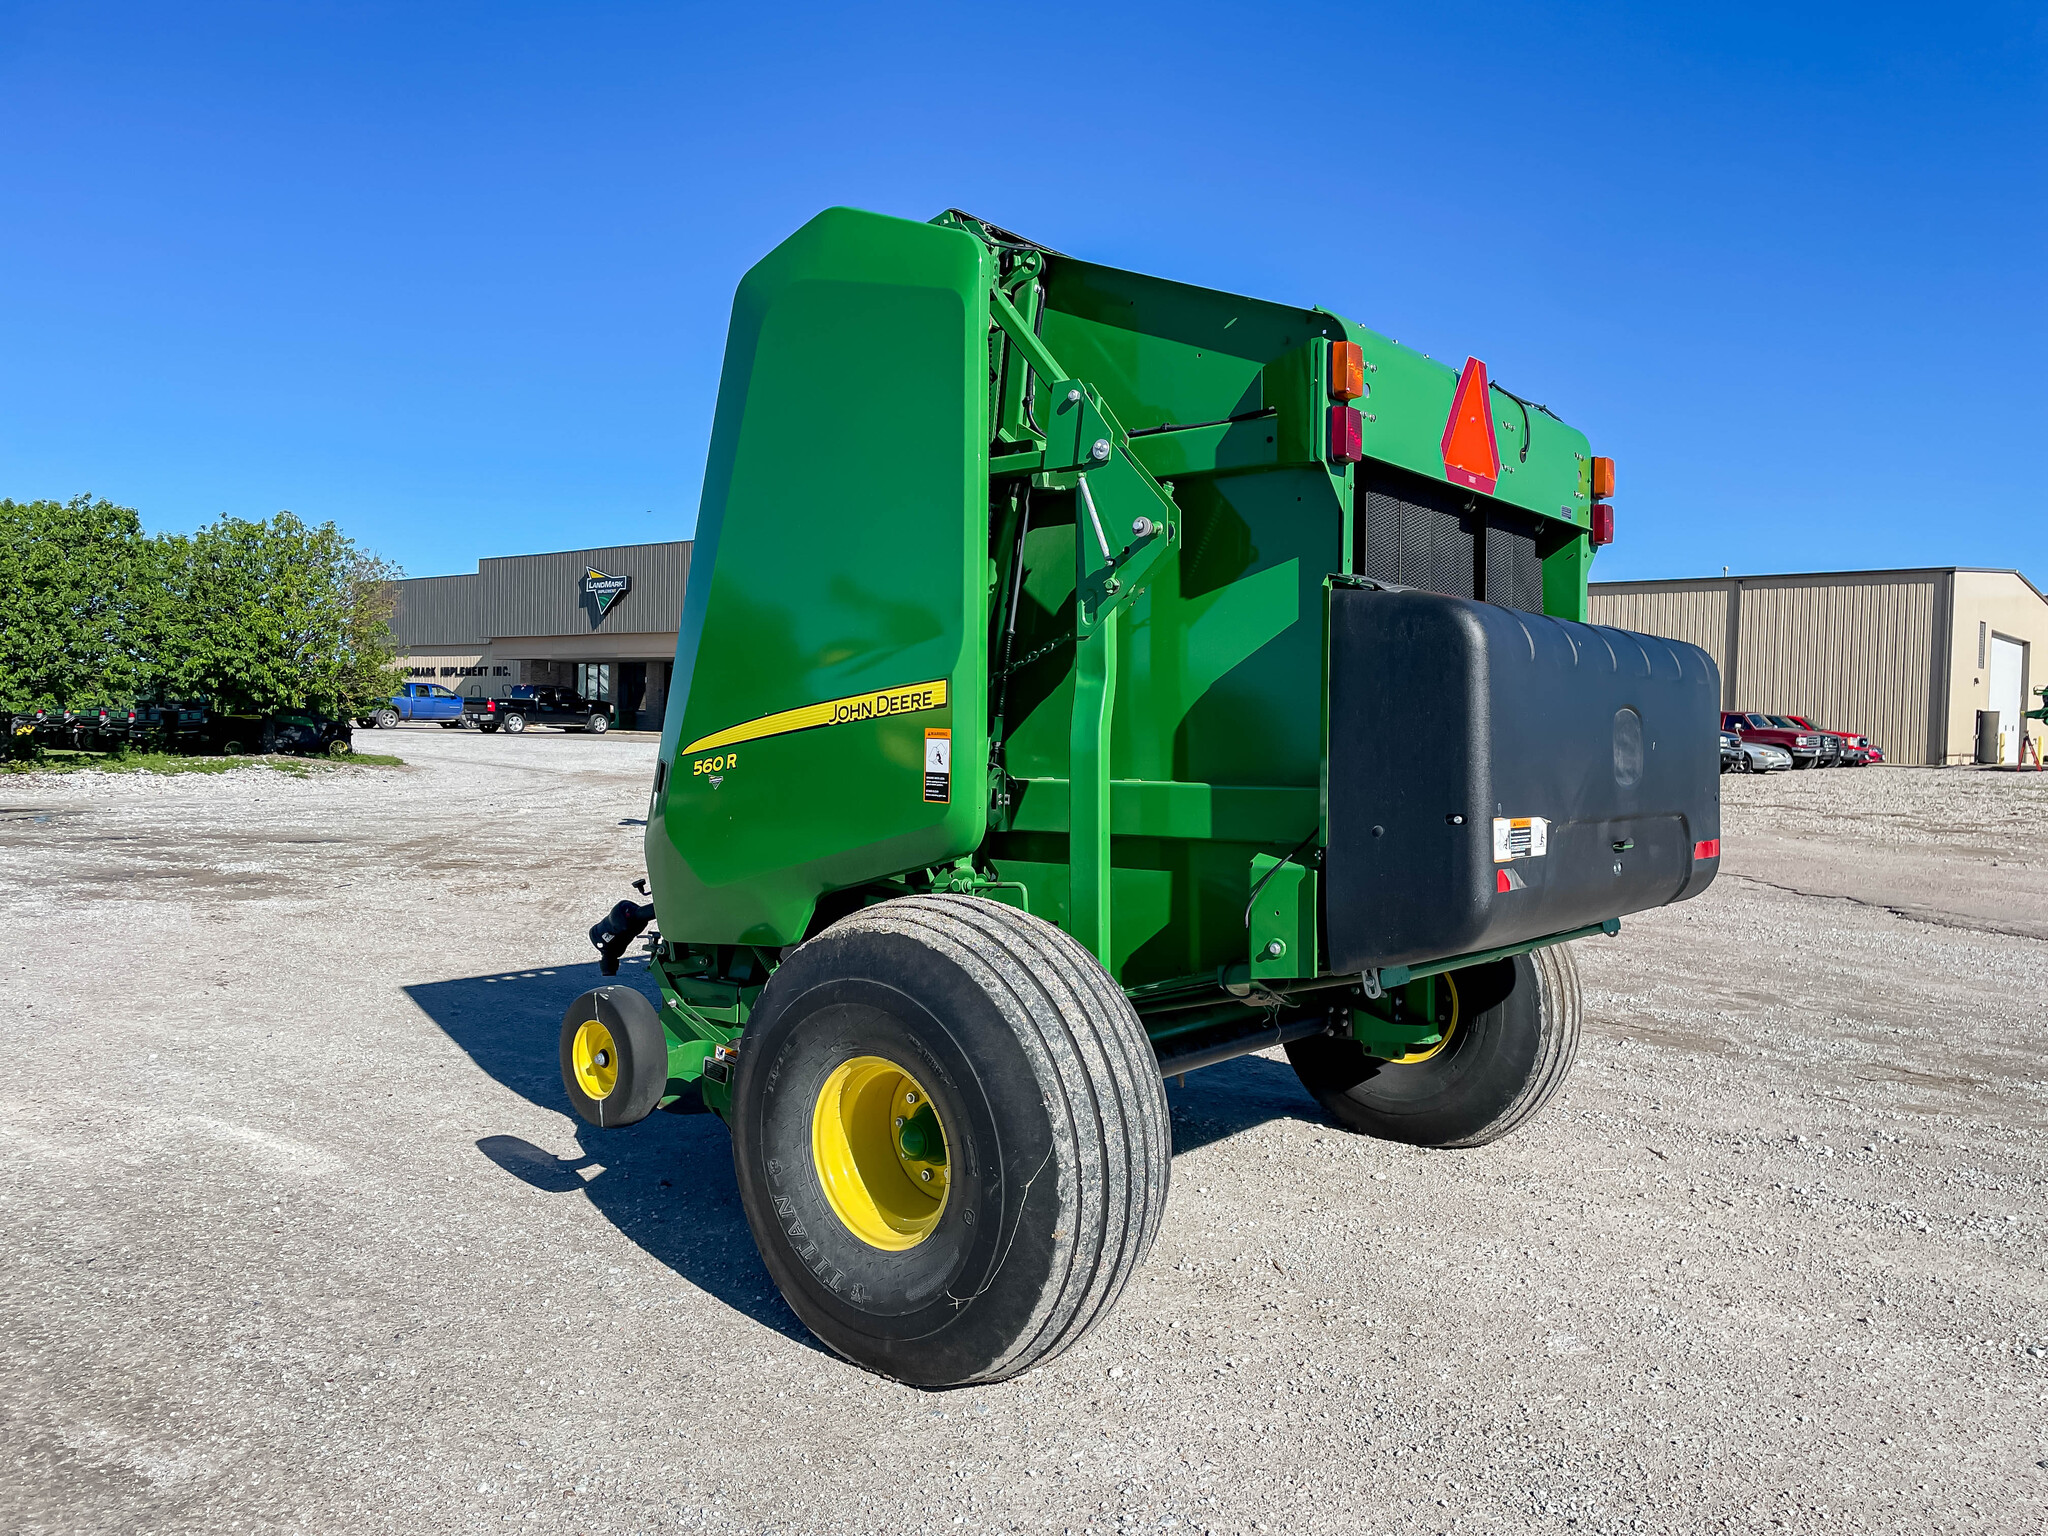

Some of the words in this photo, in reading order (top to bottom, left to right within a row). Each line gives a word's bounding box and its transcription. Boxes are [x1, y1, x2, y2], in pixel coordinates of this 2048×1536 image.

[589, 580, 623, 588] LANDMARK
[440, 666, 489, 678] IMPLEMENT
[493, 665, 511, 677] INC.
[828, 700, 873, 723] JOHN
[876, 690, 933, 714] DEERE
[693, 756, 724, 776] 560
[726, 753, 738, 770] R
[774, 1195, 845, 1294] TITAN
